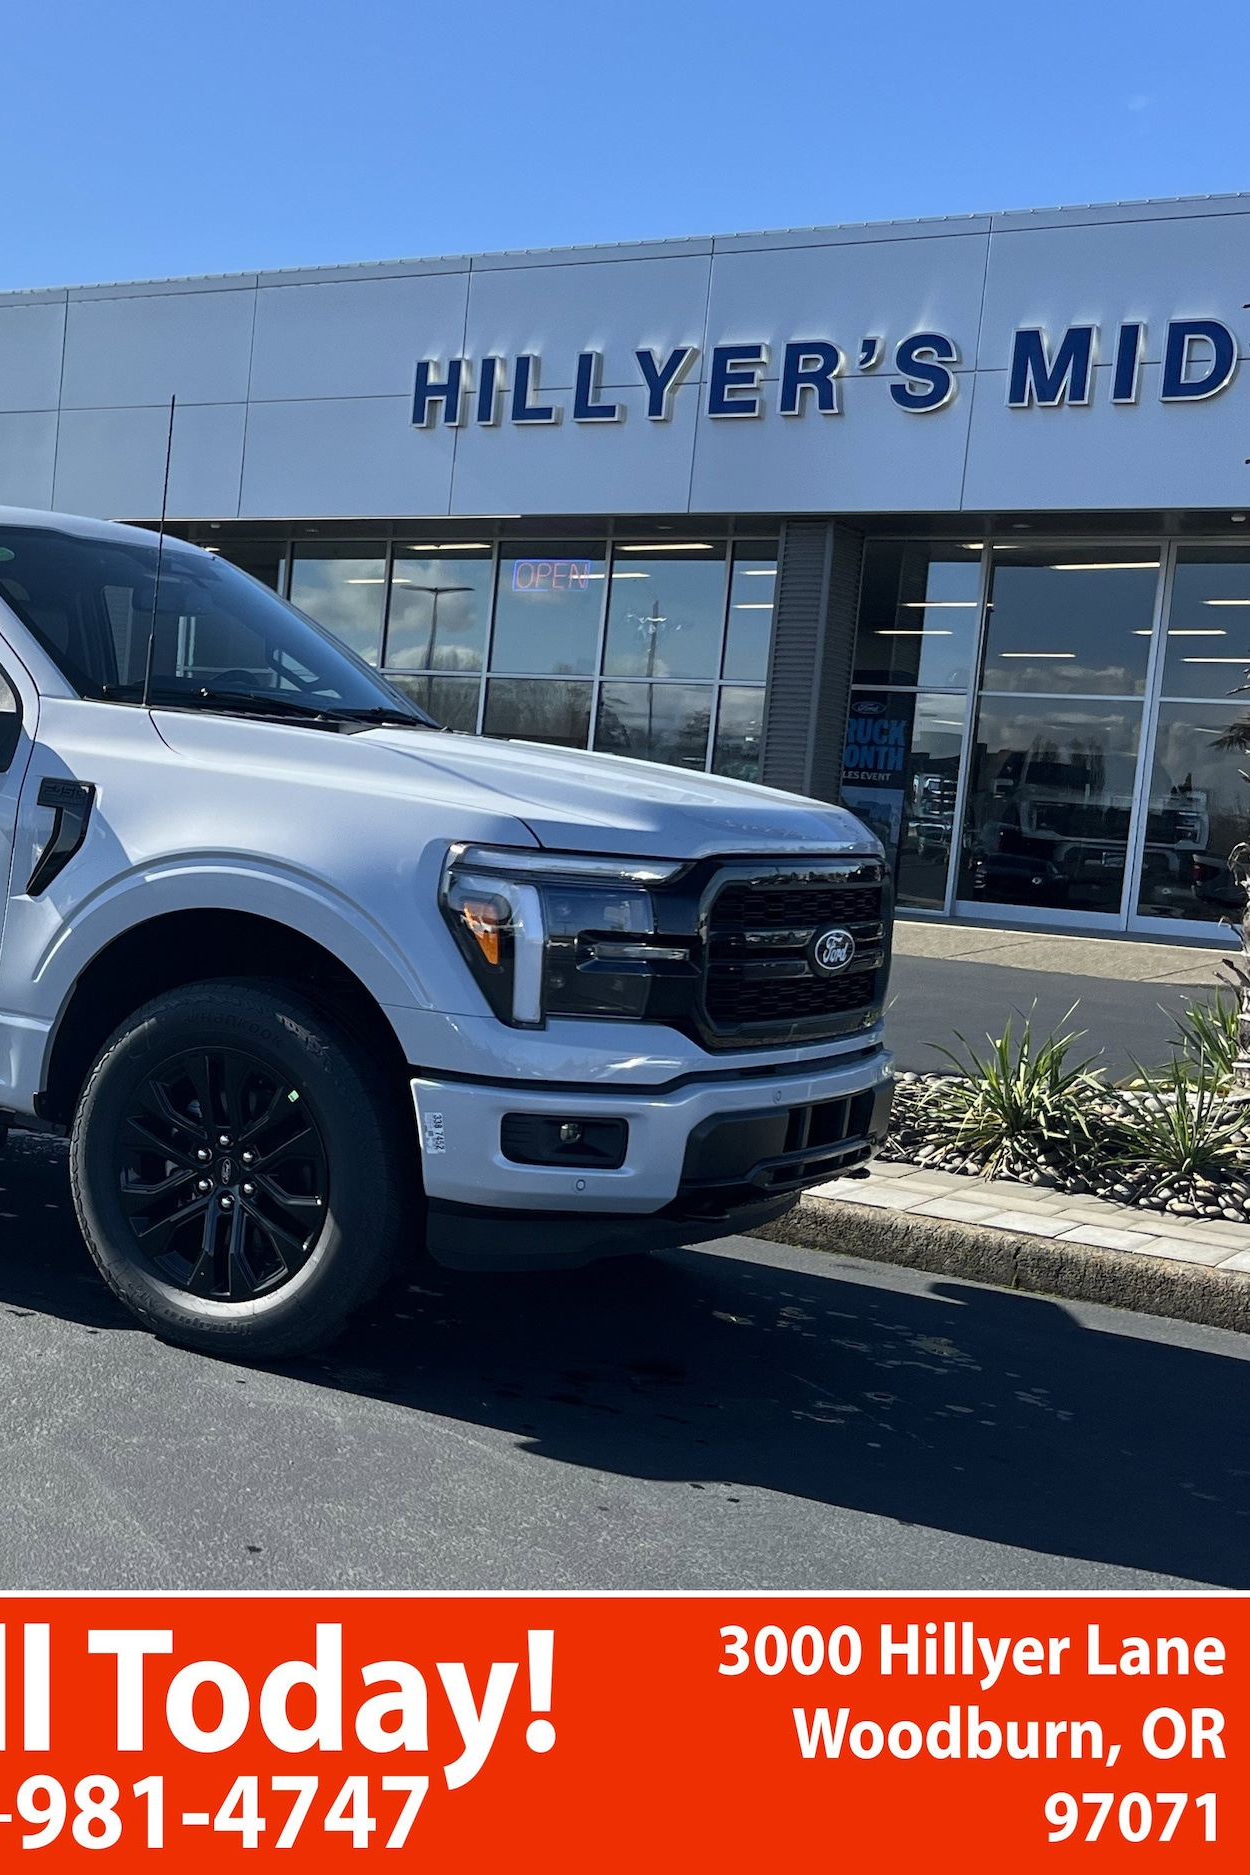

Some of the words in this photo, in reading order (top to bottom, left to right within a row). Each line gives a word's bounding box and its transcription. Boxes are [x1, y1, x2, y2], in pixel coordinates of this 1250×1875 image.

[410, 332, 959, 428] HILLYER'S
[1006, 318, 1238, 408] MID
[516, 562, 588, 589] OPEN
[860, 771, 891, 781] EVENT
[823, 936, 849, 963] Ford
[433, 1114, 443, 1129] 338
[435, 1131, 445, 1150] 7452
